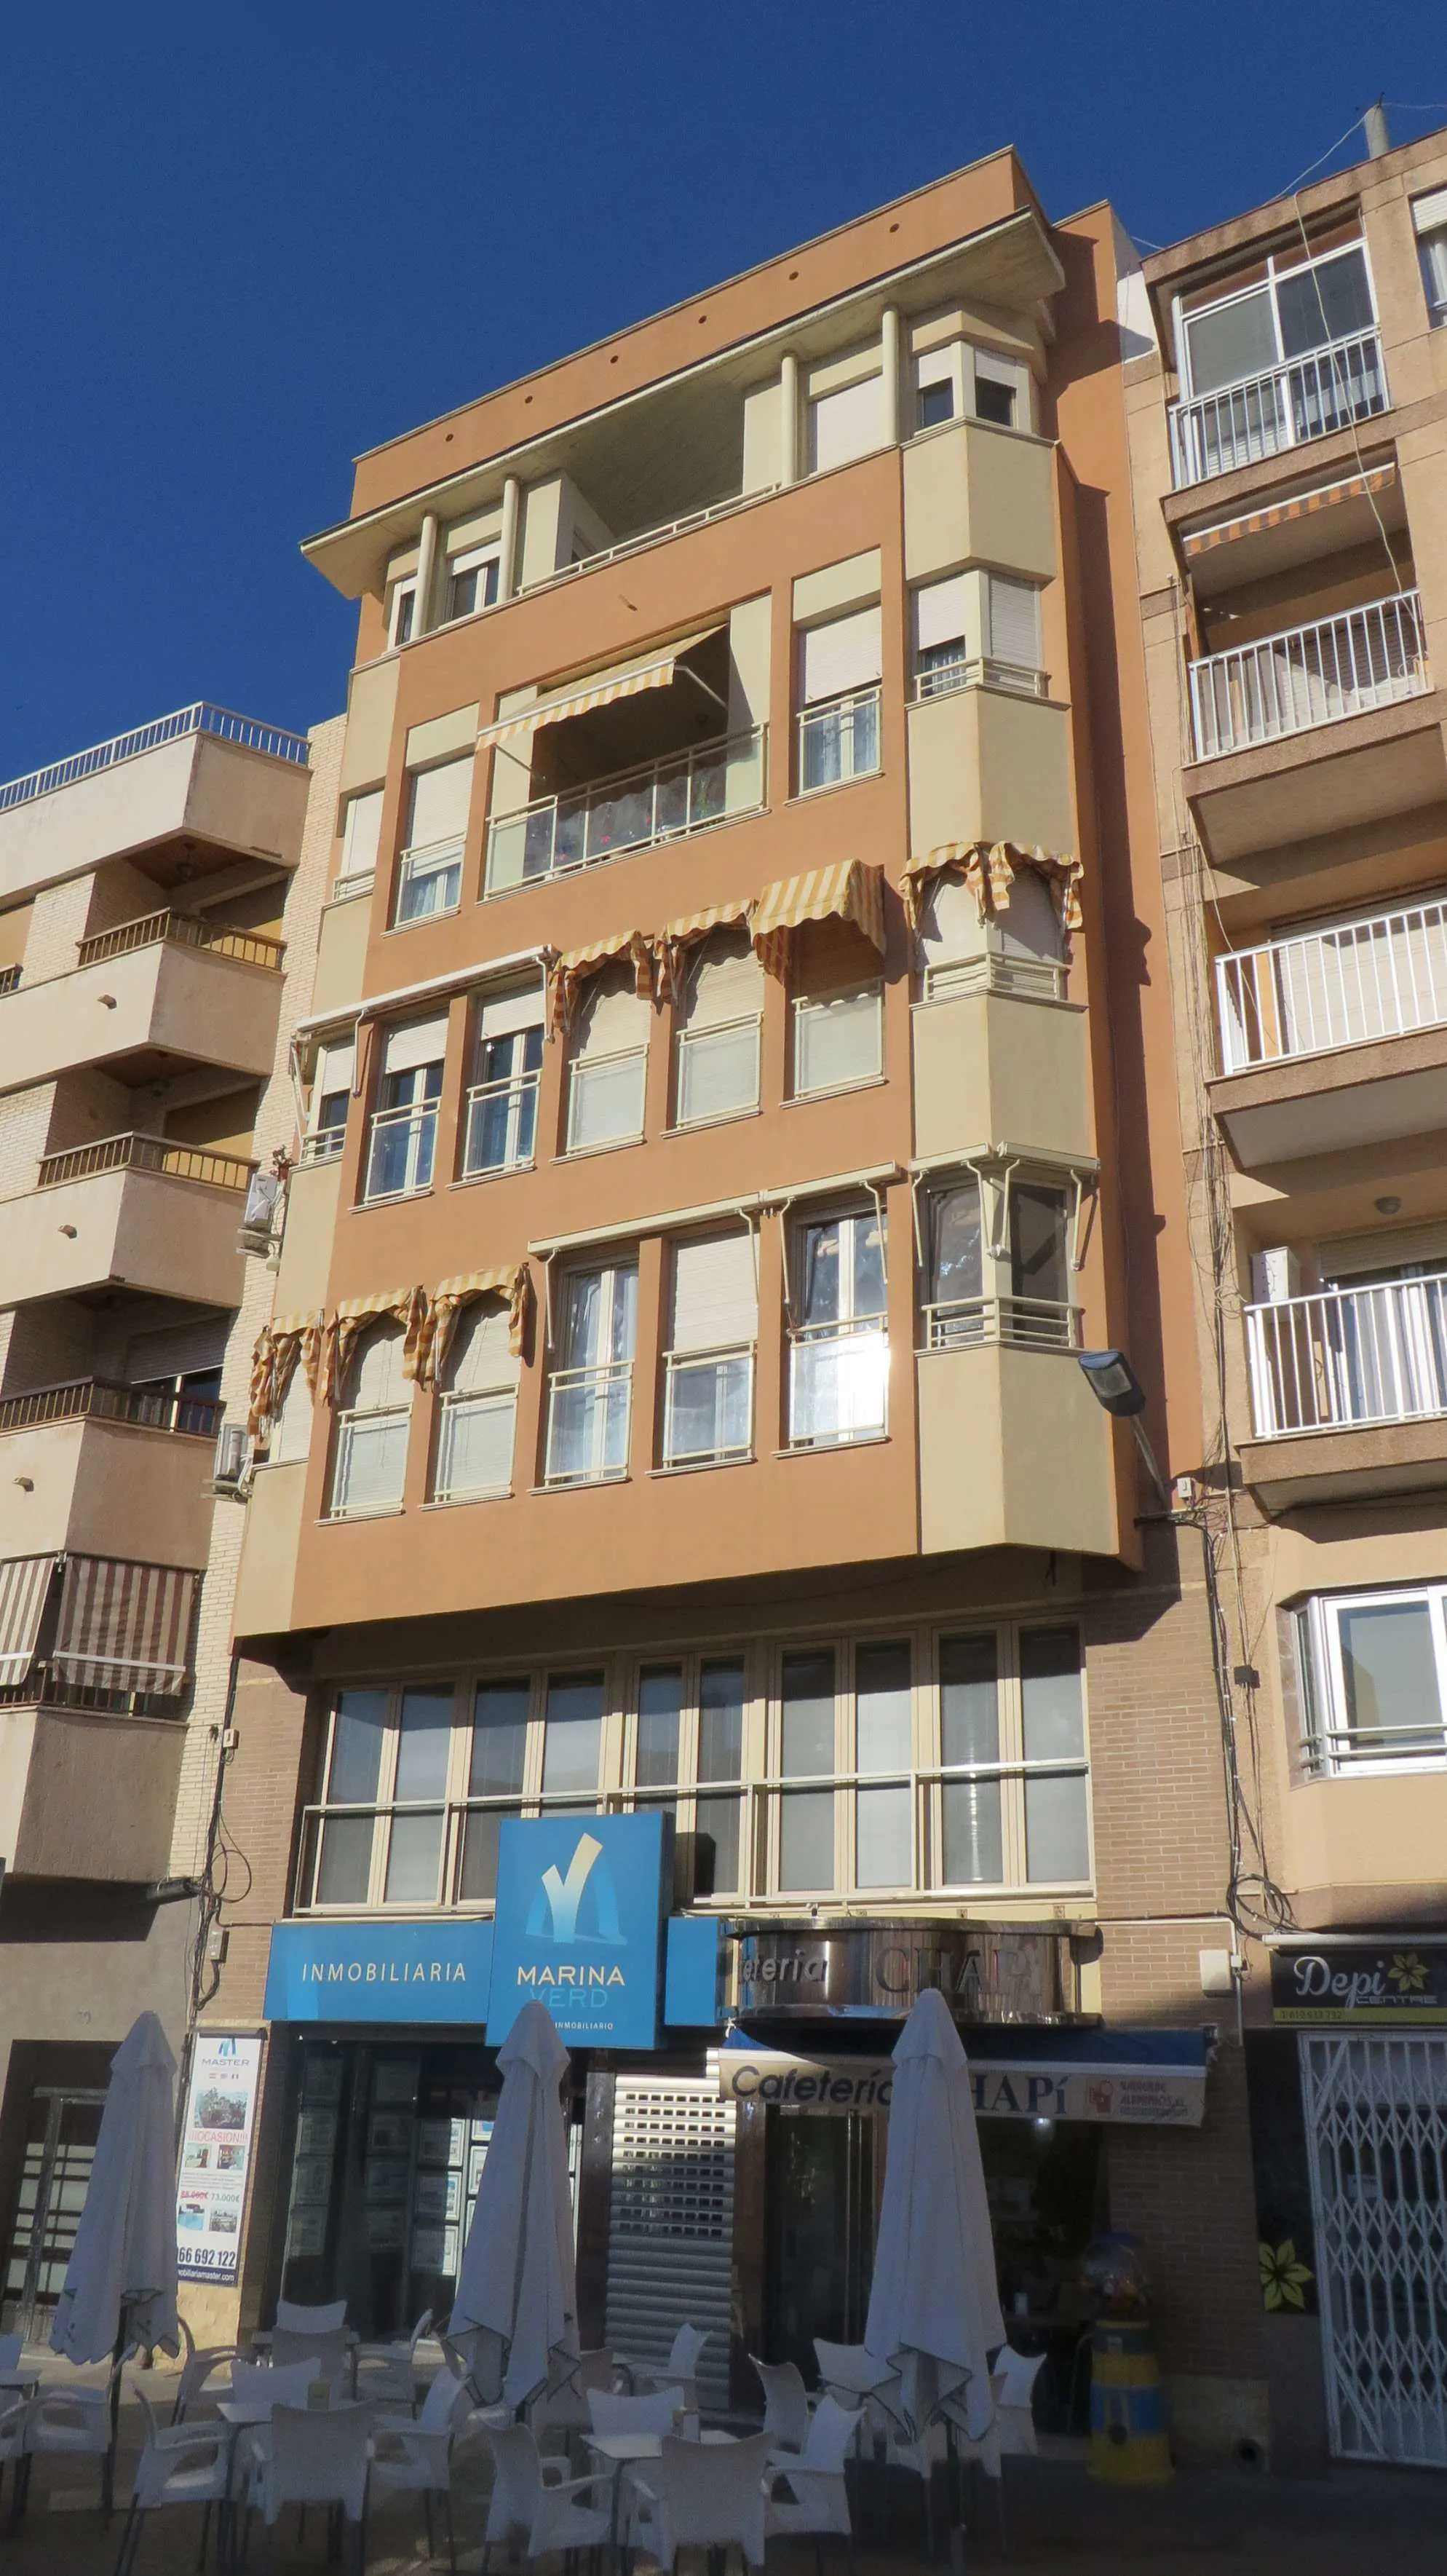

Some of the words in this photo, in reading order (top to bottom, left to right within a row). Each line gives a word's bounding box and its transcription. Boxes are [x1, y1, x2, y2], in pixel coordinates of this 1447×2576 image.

[302, 1962, 467, 1982] INMOBILIARIA
[517, 1966, 626, 1986] MARINA
[1293, 1956, 1385, 2010] Depi
[529, 1988, 608, 2008] VERD
[555, 2021, 614, 2031] INMOBILIARIO
[202, 2058, 250, 2066] MASTER
[178, 2247, 192, 2263] 66
[194, 2249, 215, 2265] 692
[218, 2251, 237, 2267] 122
